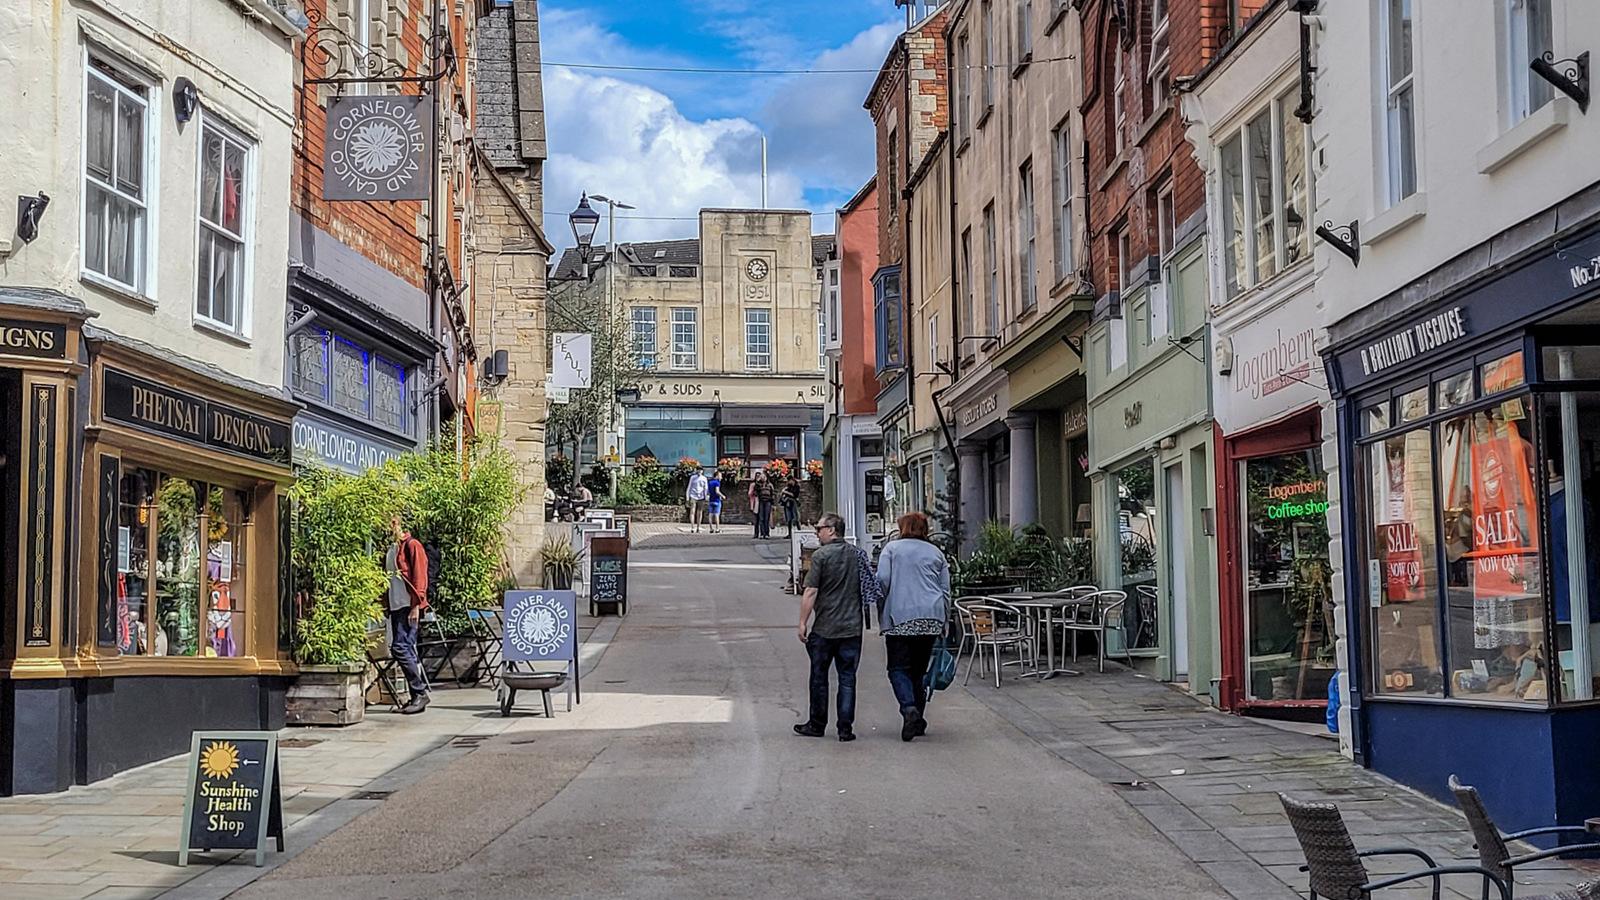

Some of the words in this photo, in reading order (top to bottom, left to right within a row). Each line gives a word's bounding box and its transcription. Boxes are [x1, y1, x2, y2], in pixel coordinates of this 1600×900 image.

[333, 100, 425, 153] CORNFLOWER
[330, 150, 378, 195] CALICO
[385, 158, 419, 192] AND
[745, 285, 769, 299] 1951
[1360, 349, 1371, 376] A
[1368, 329, 1416, 373] BRILLIANT
[1415, 307, 1466, 353] DISGUISE
[555, 335, 589, 387] BEAUTY
[640, 383, 654, 394] AP
[659, 383, 667, 395] &
[673, 383, 702, 395] SUDS
[810, 385, 826, 396] SIL
[131, 385, 200, 435] PHETSAI
[213, 411, 271, 453] DESIGNS
[292, 421, 357, 467] CORNFLOWER
[358, 444, 378, 468] AND
[1268, 501, 1304, 519] Coffee
[1304, 499, 1329, 516] shop
[1387, 522, 1419, 552] SALE
[1475, 509, 1518, 546] SALE
[1390, 562, 1406, 577] NOW
[1478, 556, 1499, 573] NOW
[596, 582, 618, 590] WASTE
[599, 575, 617, 583] ZERO
[546, 598, 569, 619] AND
[507, 595, 543, 655] CORNFLOWER
[539, 623, 570, 656] CALICO
[200, 781, 259, 798] Sunshine
[204, 797, 252, 814] Health
[207, 814, 245, 837] Shop
